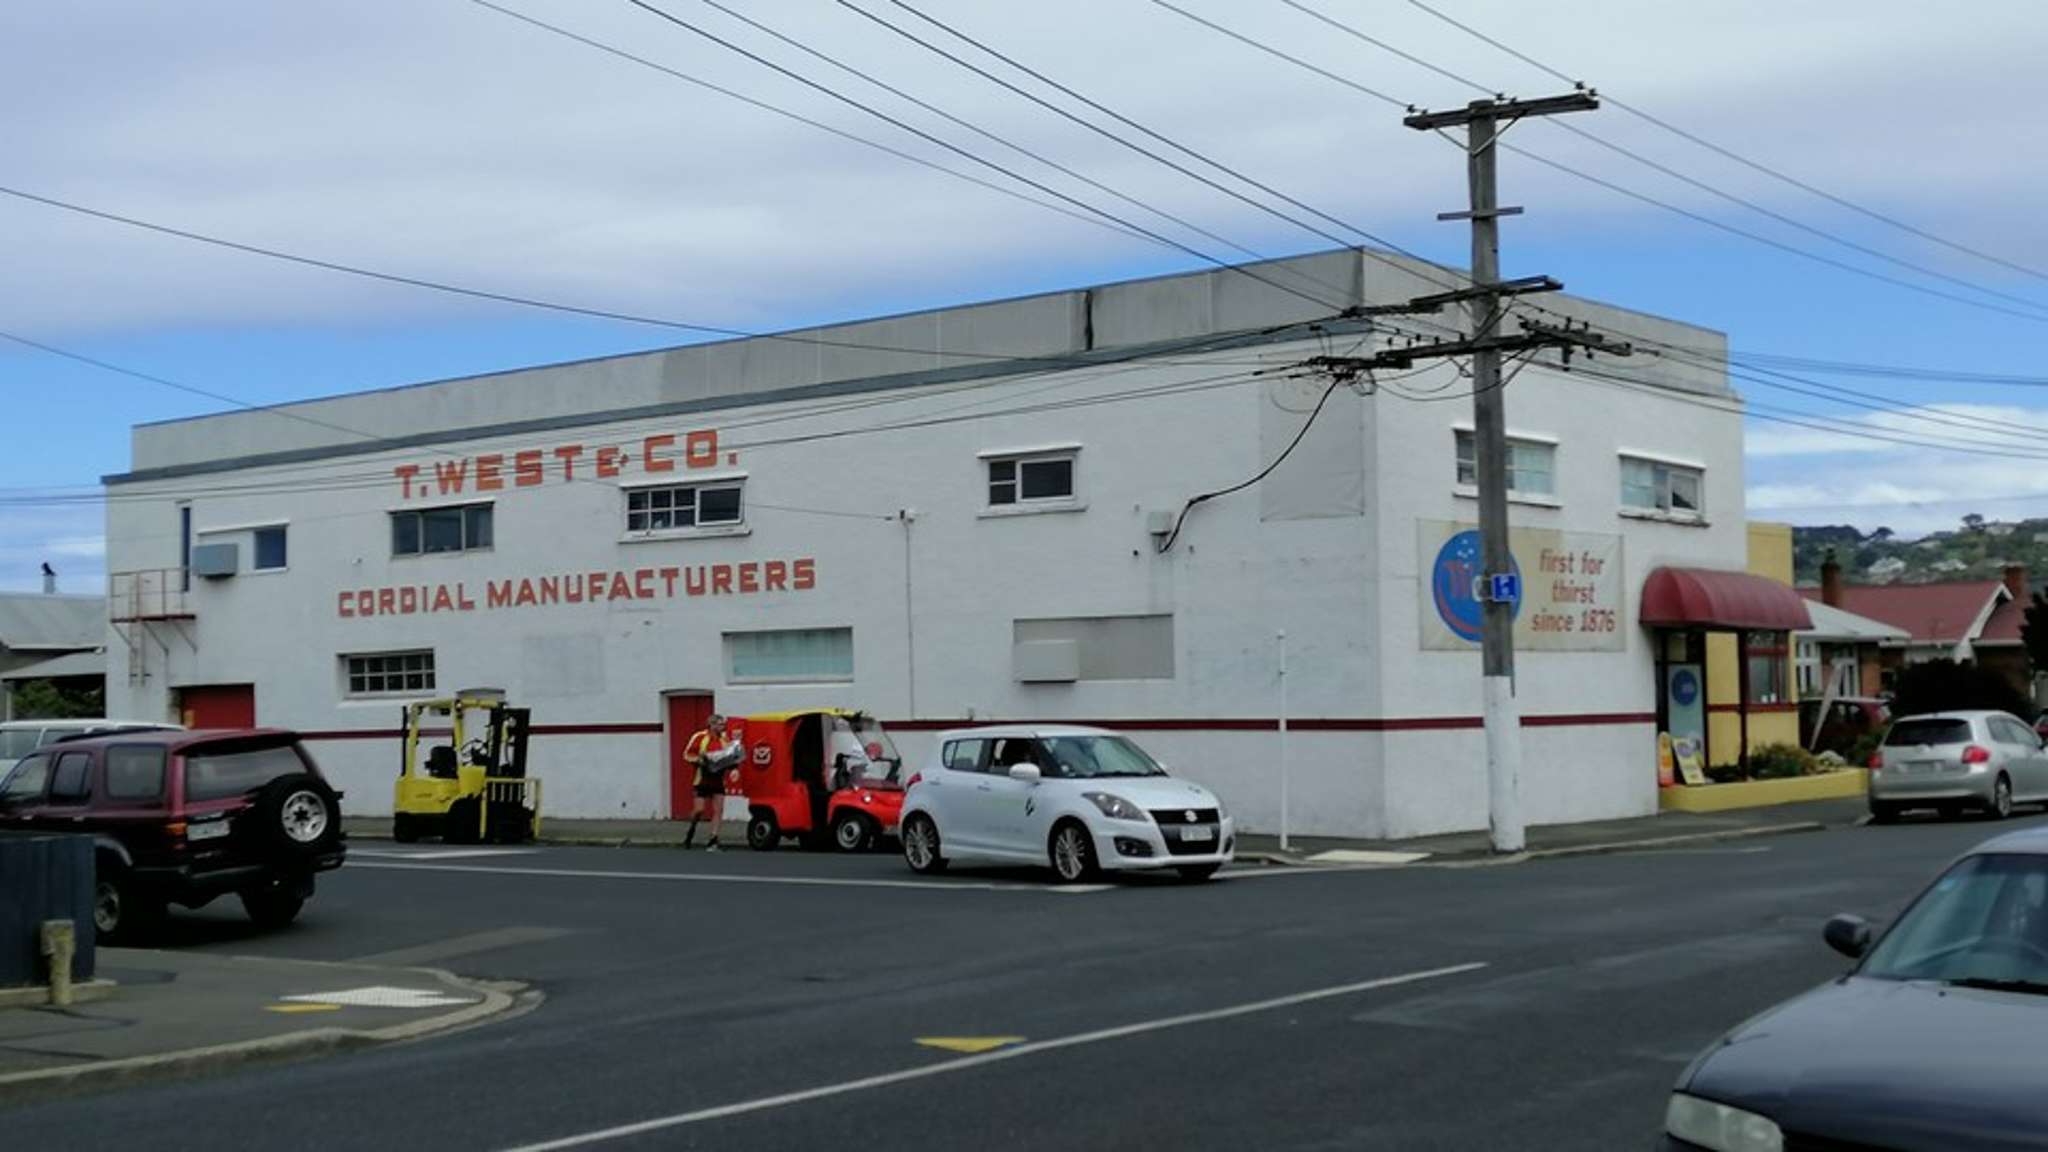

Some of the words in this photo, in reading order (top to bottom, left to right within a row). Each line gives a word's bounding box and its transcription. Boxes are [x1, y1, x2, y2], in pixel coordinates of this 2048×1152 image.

[643, 429, 739, 472] CO.
[1581, 551, 1605, 574] for
[338, 582, 476, 618] CORDIAL
[487, 558, 816, 609] MANUFACTURERS
[1552, 579, 1594, 604] thirst
[1531, 608, 1573, 632] since
[1580, 608, 1616, 632] 1876
